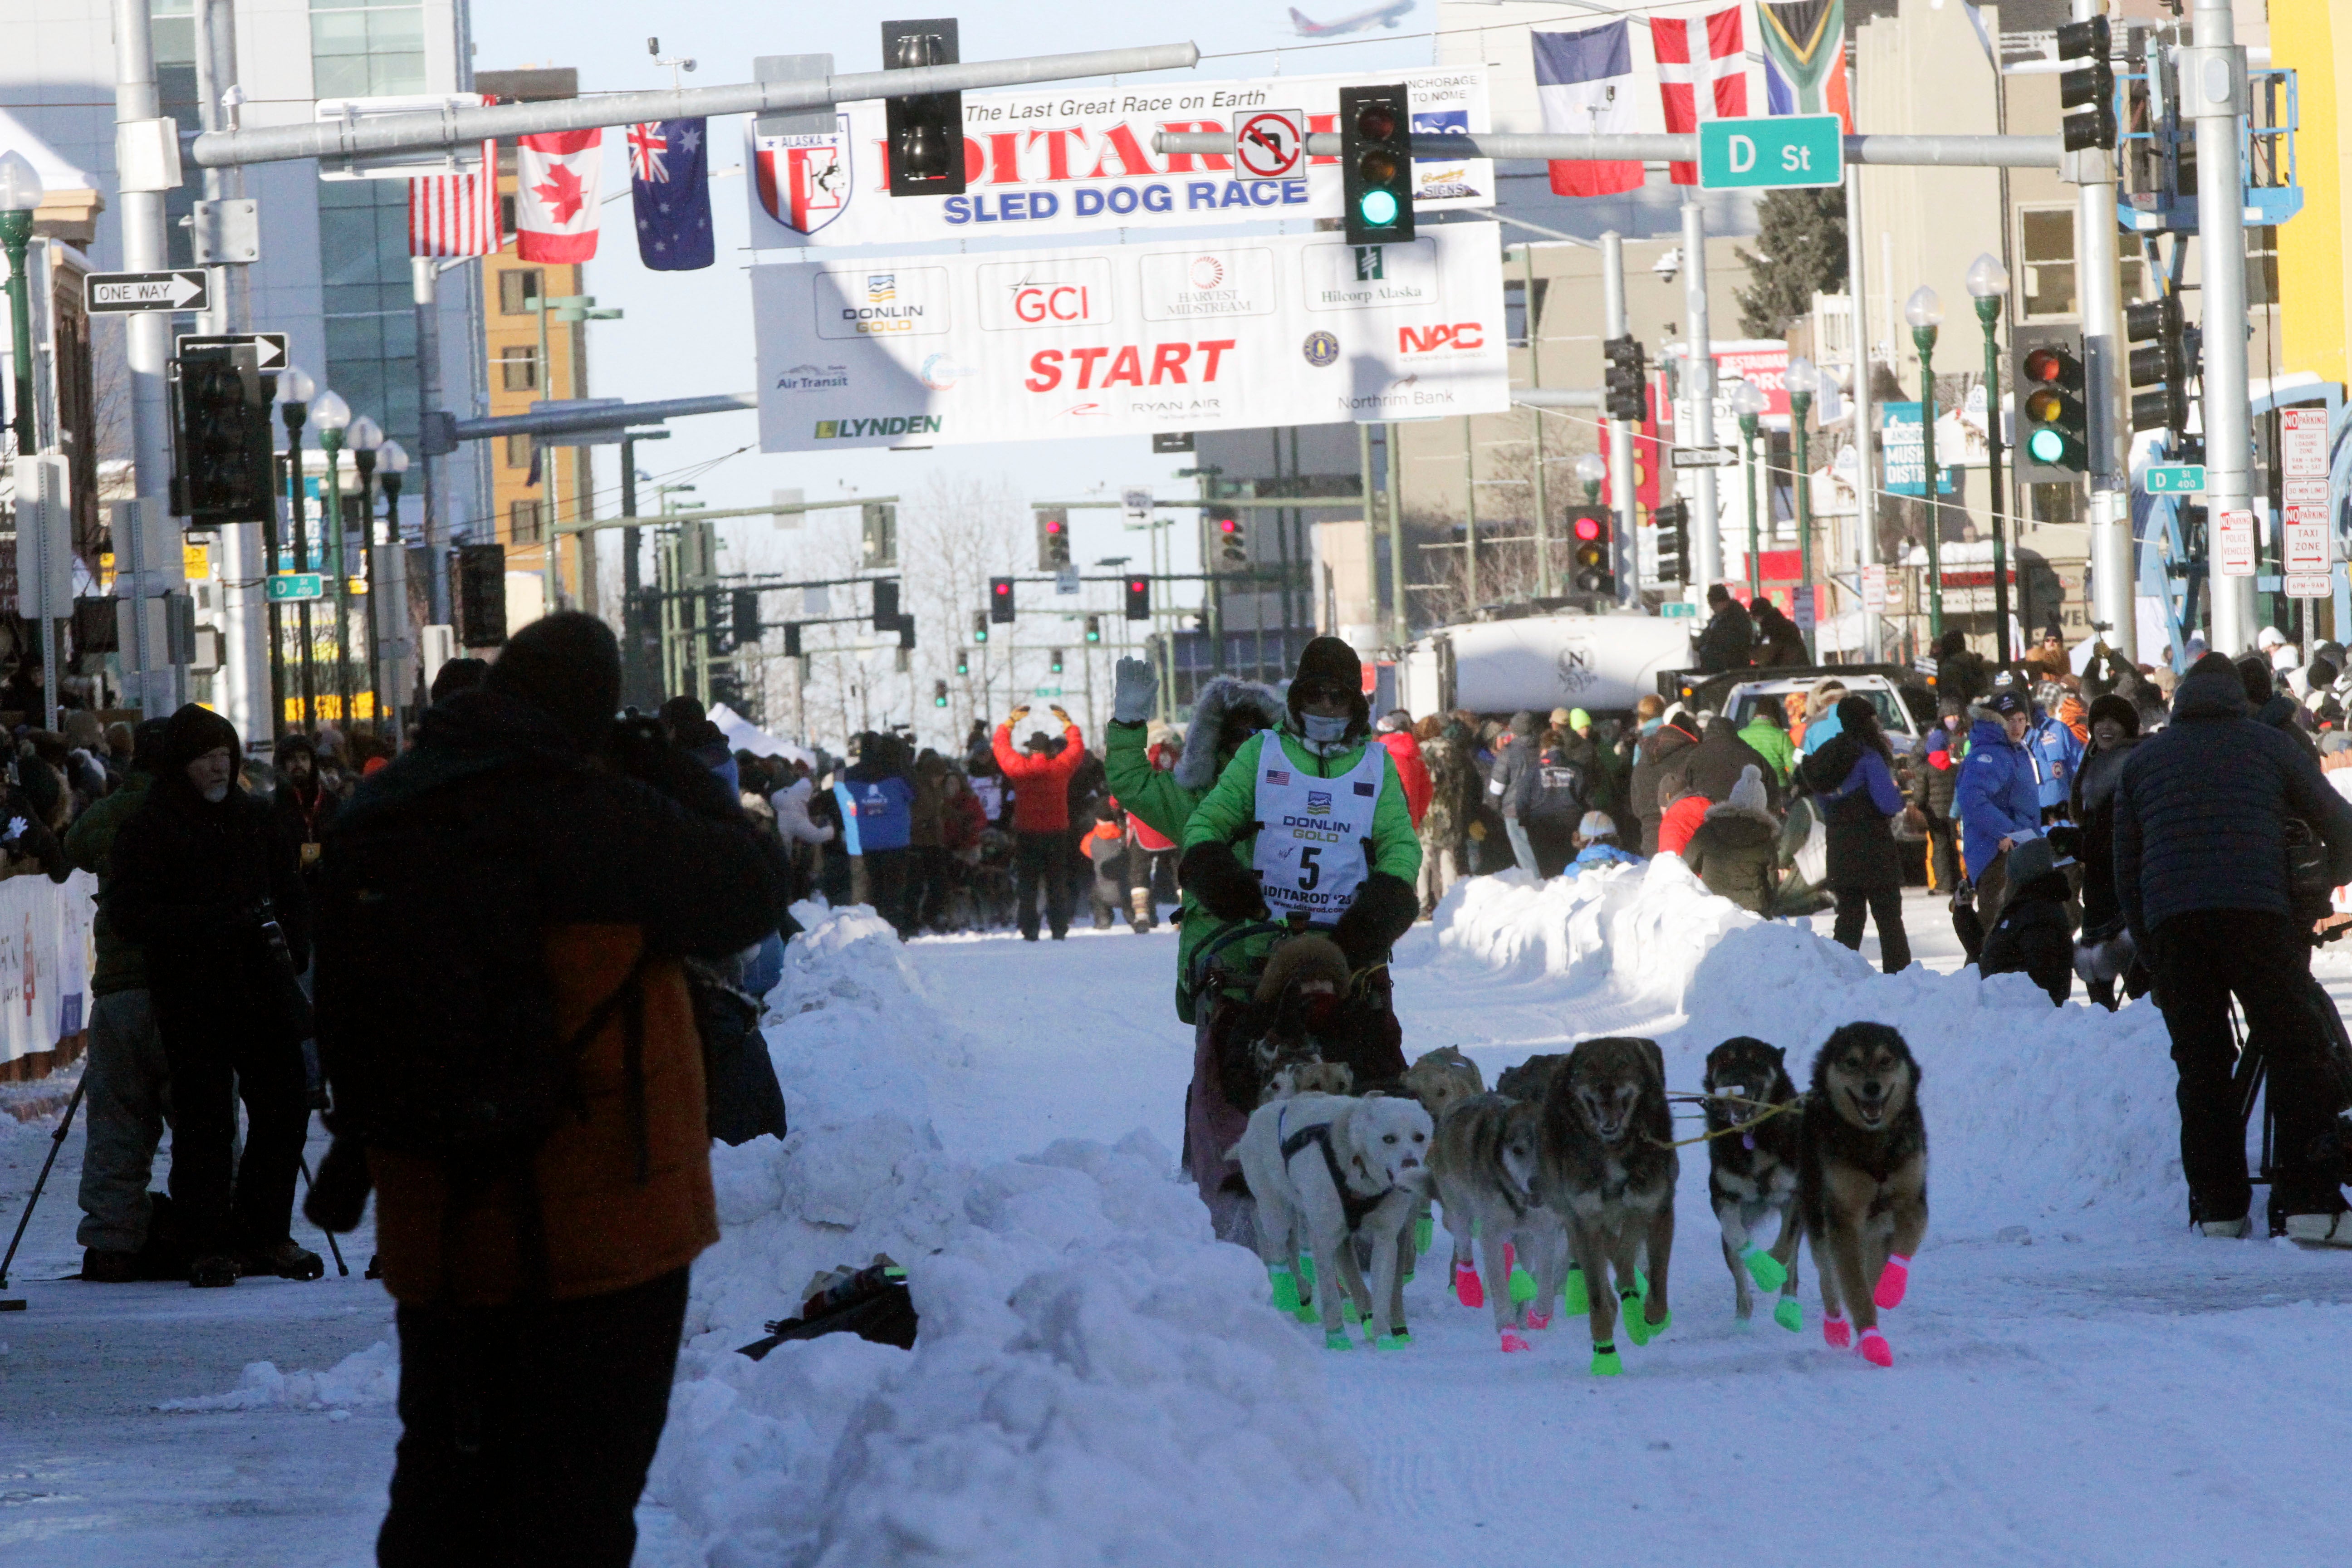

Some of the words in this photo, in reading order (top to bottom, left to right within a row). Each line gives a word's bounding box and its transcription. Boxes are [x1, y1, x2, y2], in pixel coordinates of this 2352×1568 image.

[1412, 93, 1428, 102] TO
[1431, 90, 1467, 101] NOME
[965, 105, 1001, 122] The
[1009, 103, 1053, 119] Last
[1060, 97, 1116, 117] Great
[1122, 95, 1172, 113] Race
[1180, 96, 1205, 110] on
[1212, 89, 1266, 108] Earth
[781, 135, 823, 147] ALASKA
[1729, 134, 1756, 173] D
[1781, 144, 1811, 171] St
[1425, 184, 1463, 197] SIGNS
[944, 191, 1059, 225] SLED
[1075, 183, 1173, 217] DOG
[1186, 178, 1309, 211] RACE
[99, 285, 131, 300] ONE
[137, 284, 170, 299] WAY
[1178, 289, 1238, 303] HARVEST
[1321, 290, 1372, 303] Hilcorp
[1378, 286, 1422, 299] Alaska
[843, 304, 923, 320] DONLIN
[1015, 286, 1089, 323] GCI
[1166, 300, 1251, 315] MIDSTREAM
[856, 319, 912, 333] GOLD
[1399, 322, 1484, 353] NAC
[1025, 338, 1236, 393] START
[777, 377, 798, 389] Air
[800, 376, 848, 387] Transit
[1132, 401, 1182, 412] RYAN
[1190, 398, 1220, 409] AIR
[1338, 393, 1407, 409] Northrim
[1414, 389, 1455, 405] Bank
[839, 415, 942, 437] LYNDEN
[2285, 413, 2298, 427] NO
[2298, 416, 2326, 424] PARKING
[2155, 472, 2166, 488] D
[2181, 470, 2190, 478] St
[2177, 480, 2195, 489] 400
[2220, 515, 2230, 527] NO
[2287, 509, 2299, 522] NO
[2300, 511, 2327, 519] PARKING
[2226, 534, 2247, 543] POLICE
[2298, 529, 2318, 538] TAXI
[2224, 547, 2251, 555] VEHICLES
[2295, 542, 2321, 551] ZONE
[276, 580, 287, 594] D
[1568, 650, 1585, 667] N
[1284, 815, 1351, 833] DONLIN
[1293, 828, 1339, 843] GOLD
[1298, 846, 1322, 891] 5
[1264, 885, 1329, 904] IDITAROD
